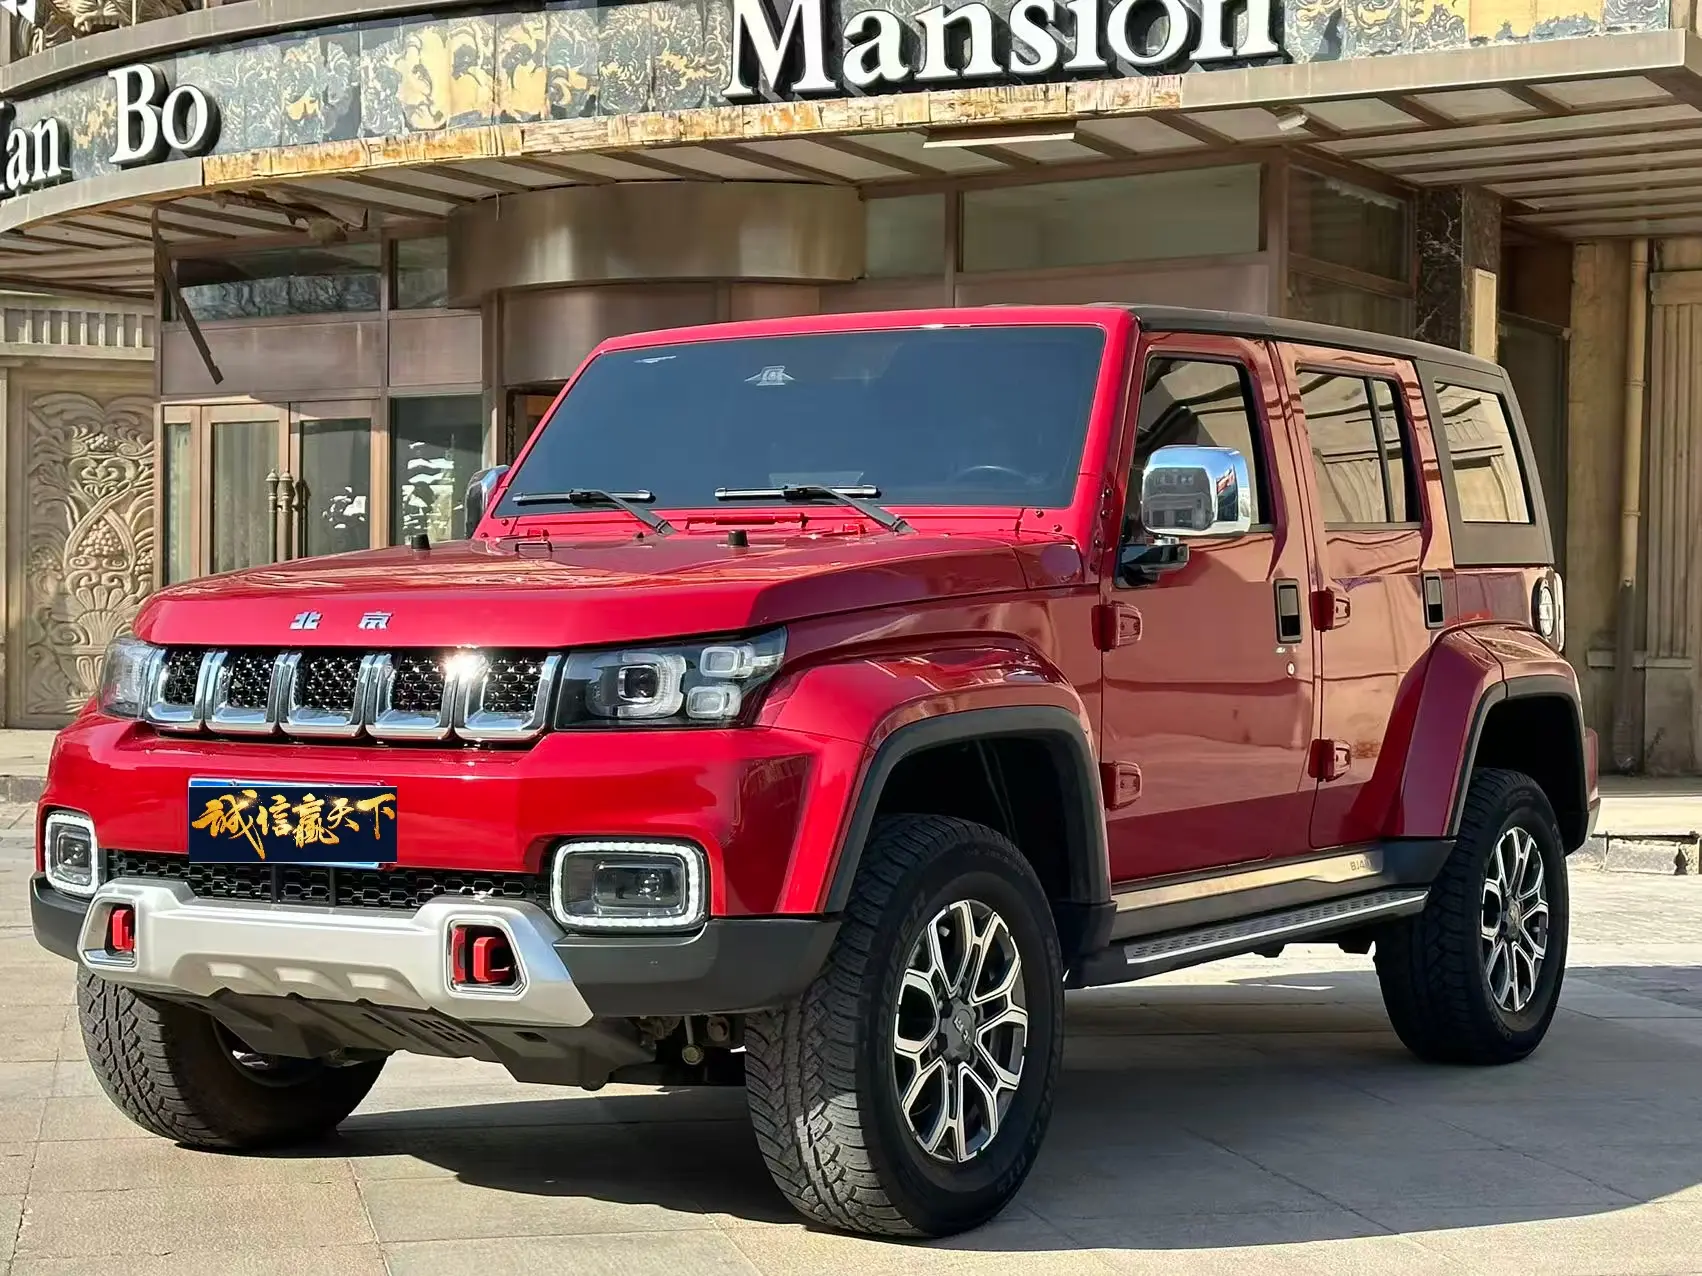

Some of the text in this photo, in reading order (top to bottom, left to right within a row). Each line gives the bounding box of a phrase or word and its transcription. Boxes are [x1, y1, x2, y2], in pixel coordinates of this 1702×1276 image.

[0, 0, 1279, 190] an Bo Mansion
[289, 610, 393, 630] 北京
